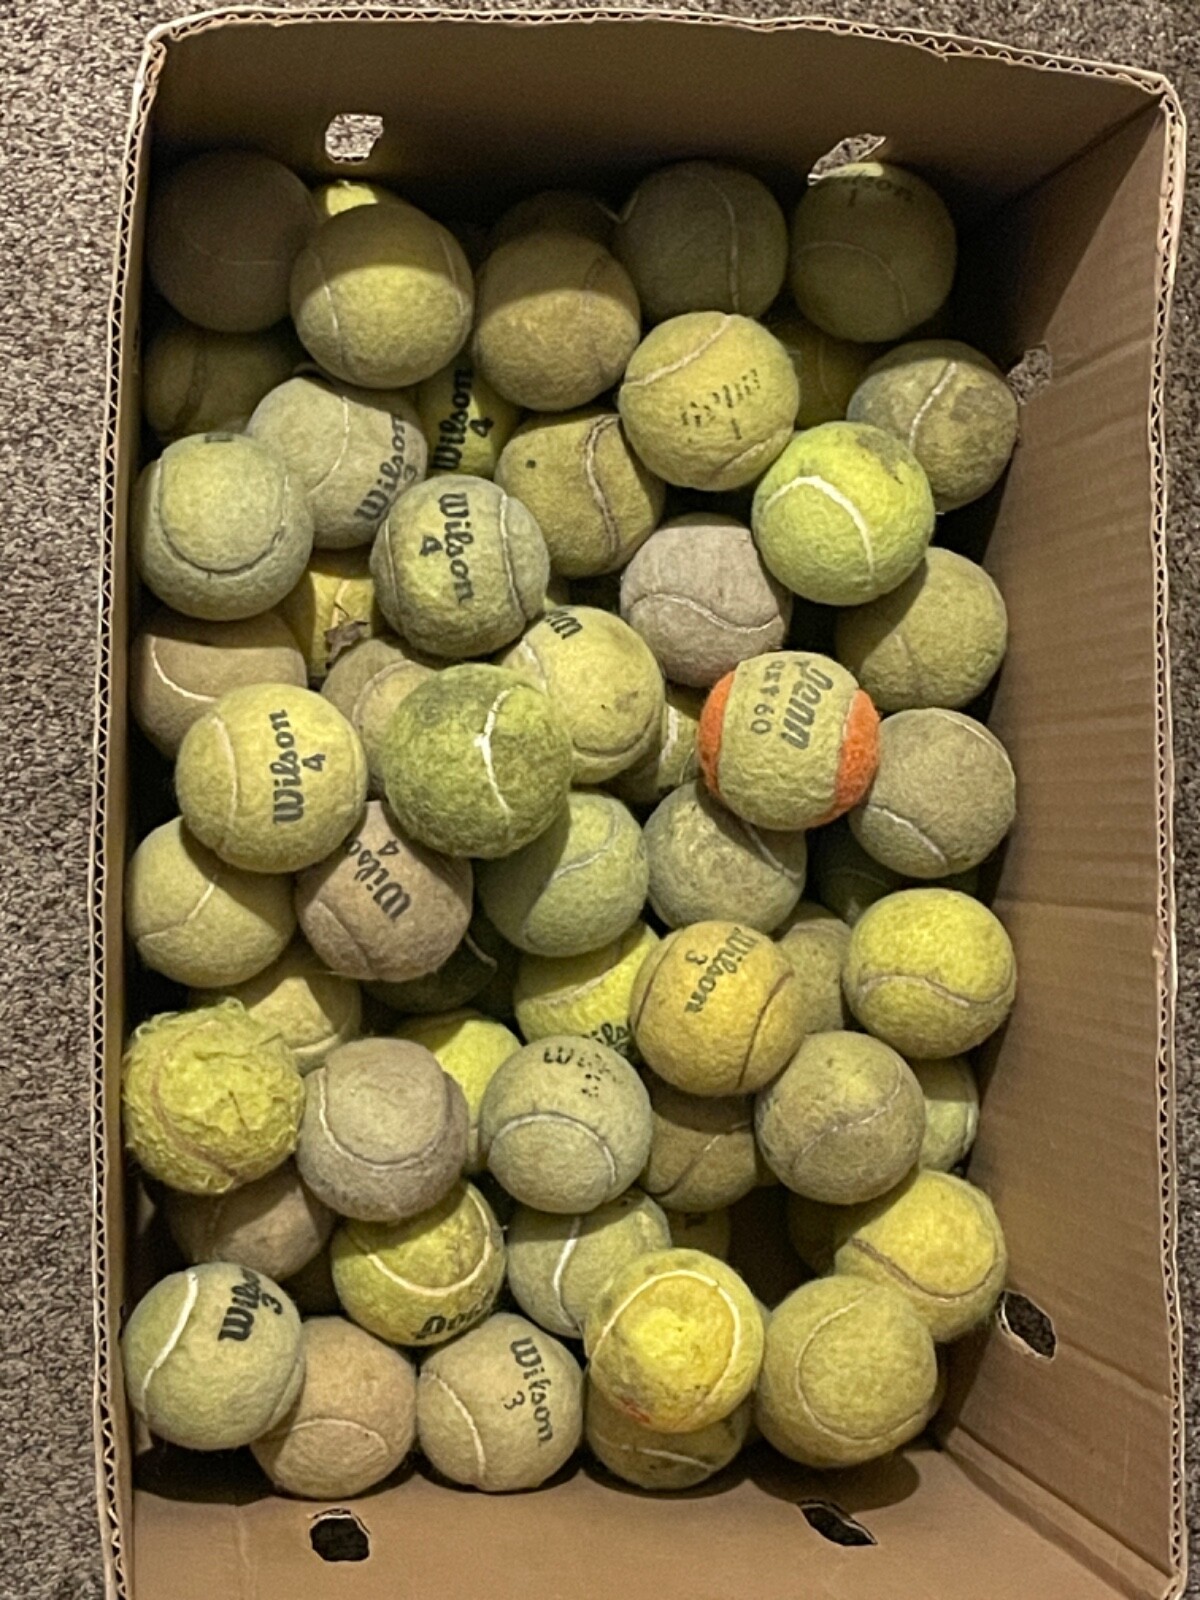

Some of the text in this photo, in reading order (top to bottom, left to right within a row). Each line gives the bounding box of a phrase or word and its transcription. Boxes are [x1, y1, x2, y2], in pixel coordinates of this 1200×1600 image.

[431, 367, 474, 470] Wilson
[470, 416, 494, 438] 4
[419, 534, 443, 556] 4
[438, 492, 474, 604] Wilson
[750, 703, 775, 735] 60
[269, 709, 304, 824] Wilson
[301, 753, 326, 772] 4
[379, 839, 399, 856] 4
[348, 840, 411, 922] Wilso
[684, 927, 758, 1014] Wilson
[685, 950, 709, 965] 3
[261, 1293, 283, 1315] 3
[503, 1390, 526, 1411] 3
[509, 1336, 553, 1447] Wilson
